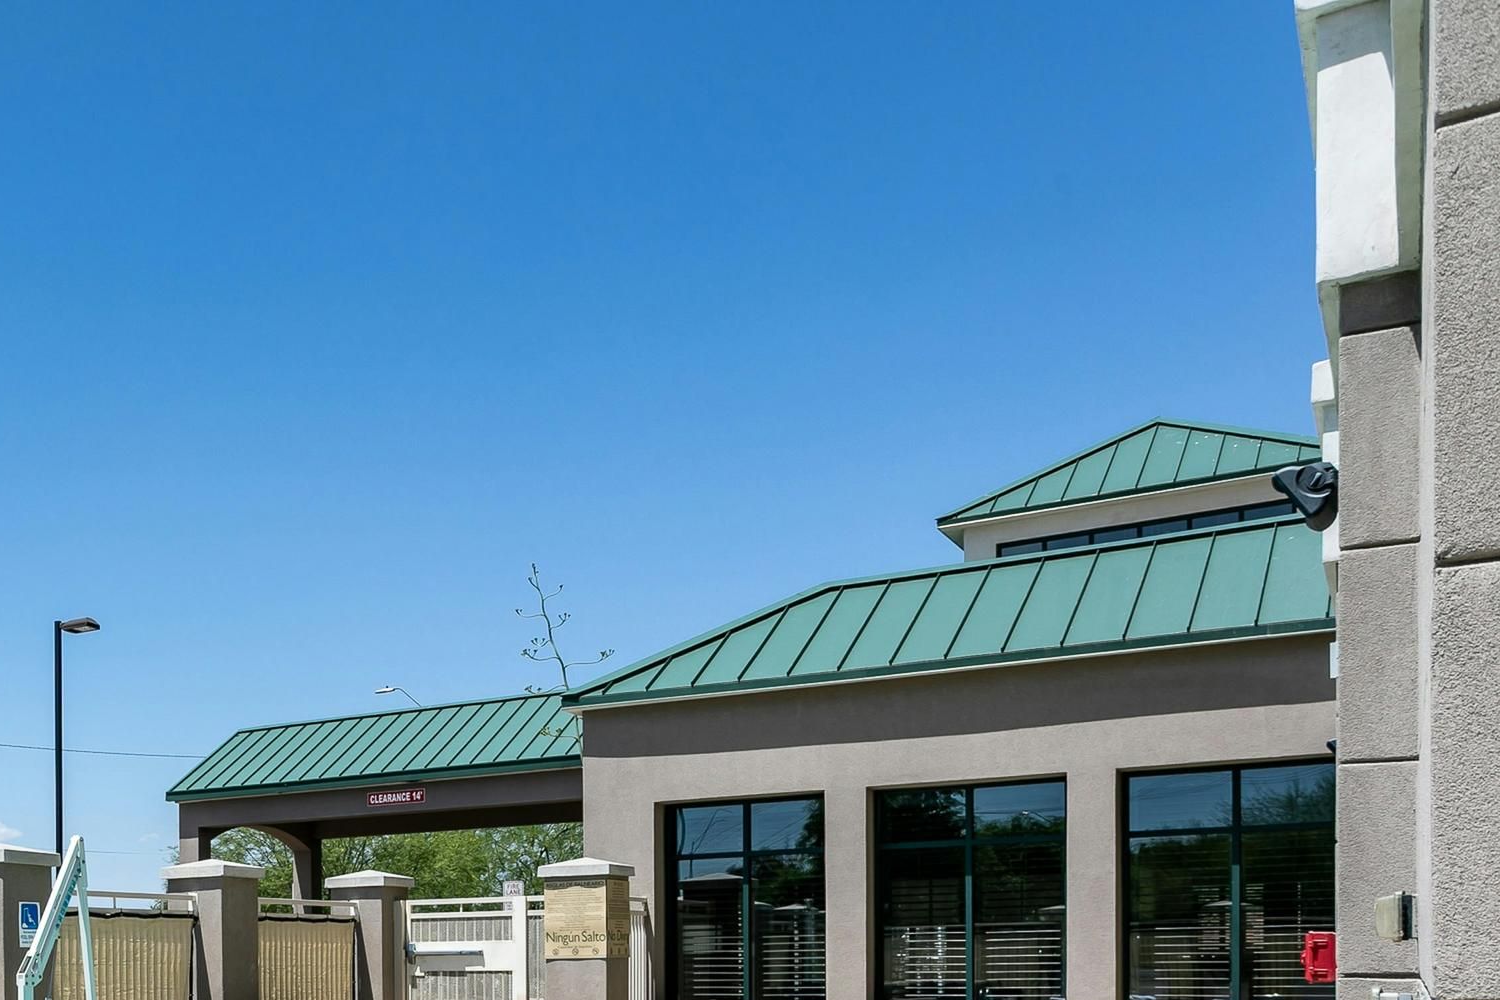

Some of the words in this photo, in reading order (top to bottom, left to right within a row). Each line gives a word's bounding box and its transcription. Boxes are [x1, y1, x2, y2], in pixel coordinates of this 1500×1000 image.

[369, 791, 411, 804] CLEARANCE
[412, 790, 423, 801] 14'
[546, 931, 580, 945] Ningún
[581, 930, 606, 942] Salto
